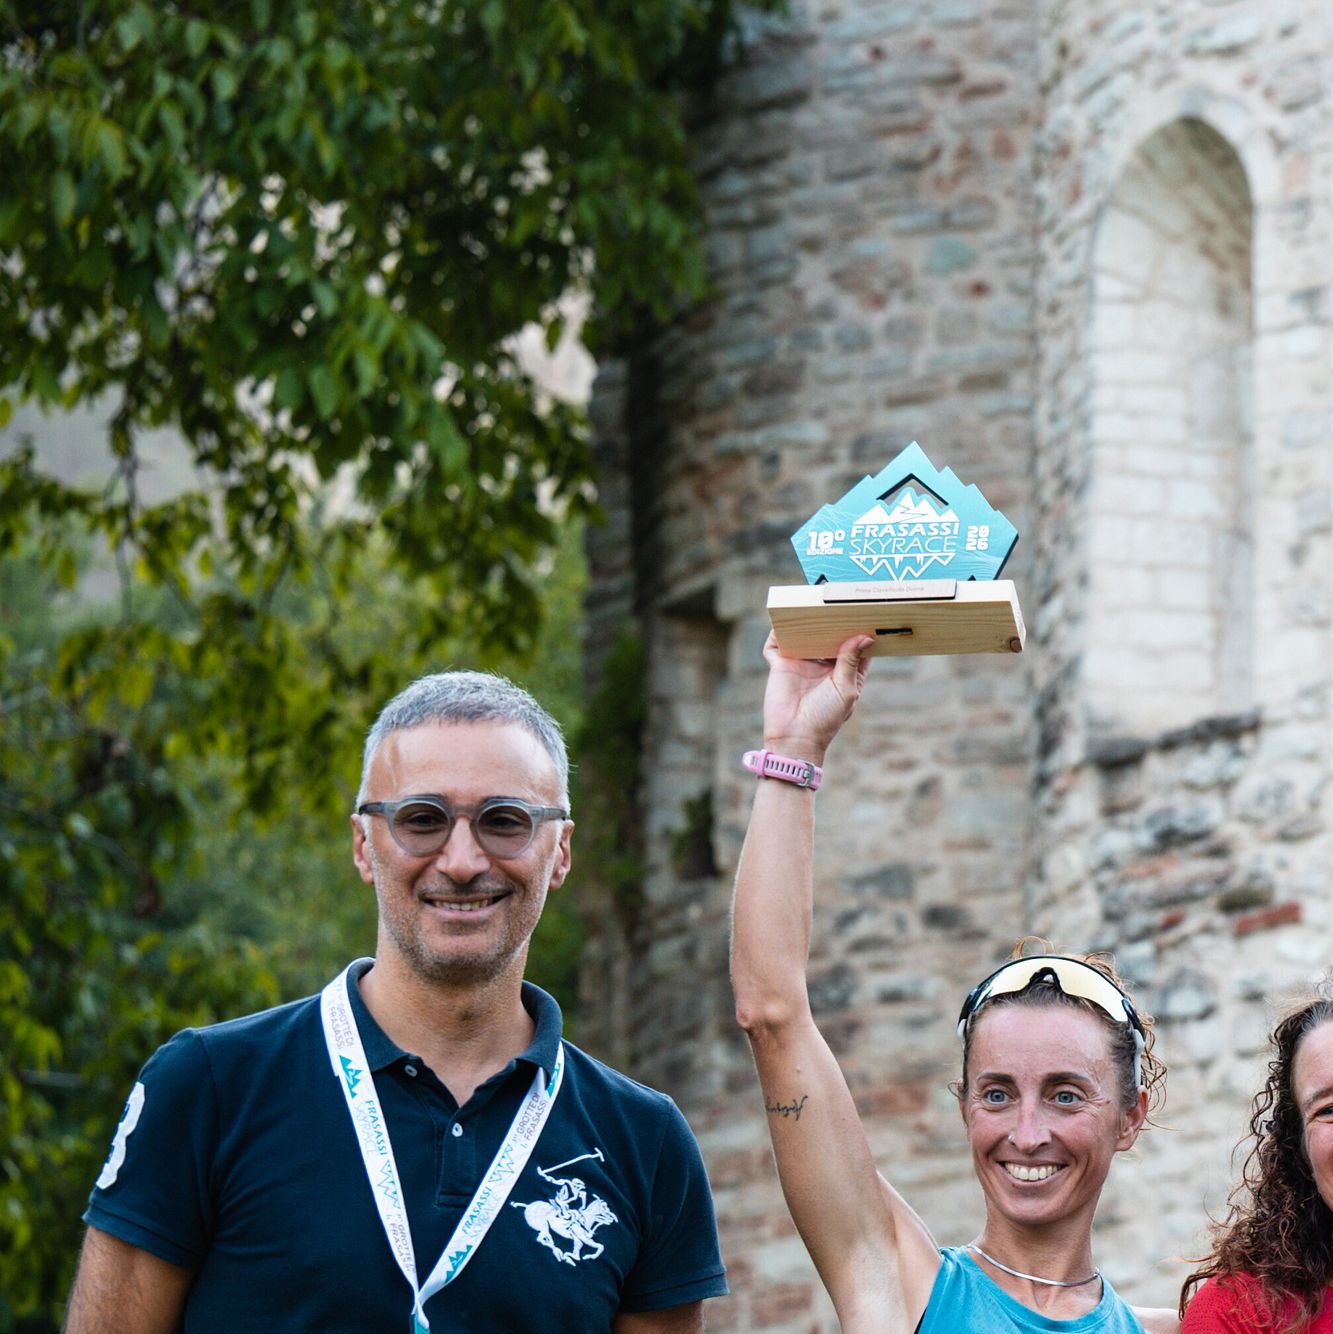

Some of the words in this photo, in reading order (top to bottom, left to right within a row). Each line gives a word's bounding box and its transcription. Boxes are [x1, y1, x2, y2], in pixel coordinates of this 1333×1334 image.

[850, 522, 960, 538] FRASASSI
[967, 525, 990, 538] 20
[807, 548, 843, 556] EDIZIONE
[849, 536, 957, 555] SKYRACE
[365, 1100, 388, 1156] FRASASSI
[516, 1102, 537, 1134] GROTTE
[524, 1099, 548, 1142] FRASASSI
[461, 1187, 493, 1235] FRASASSI
